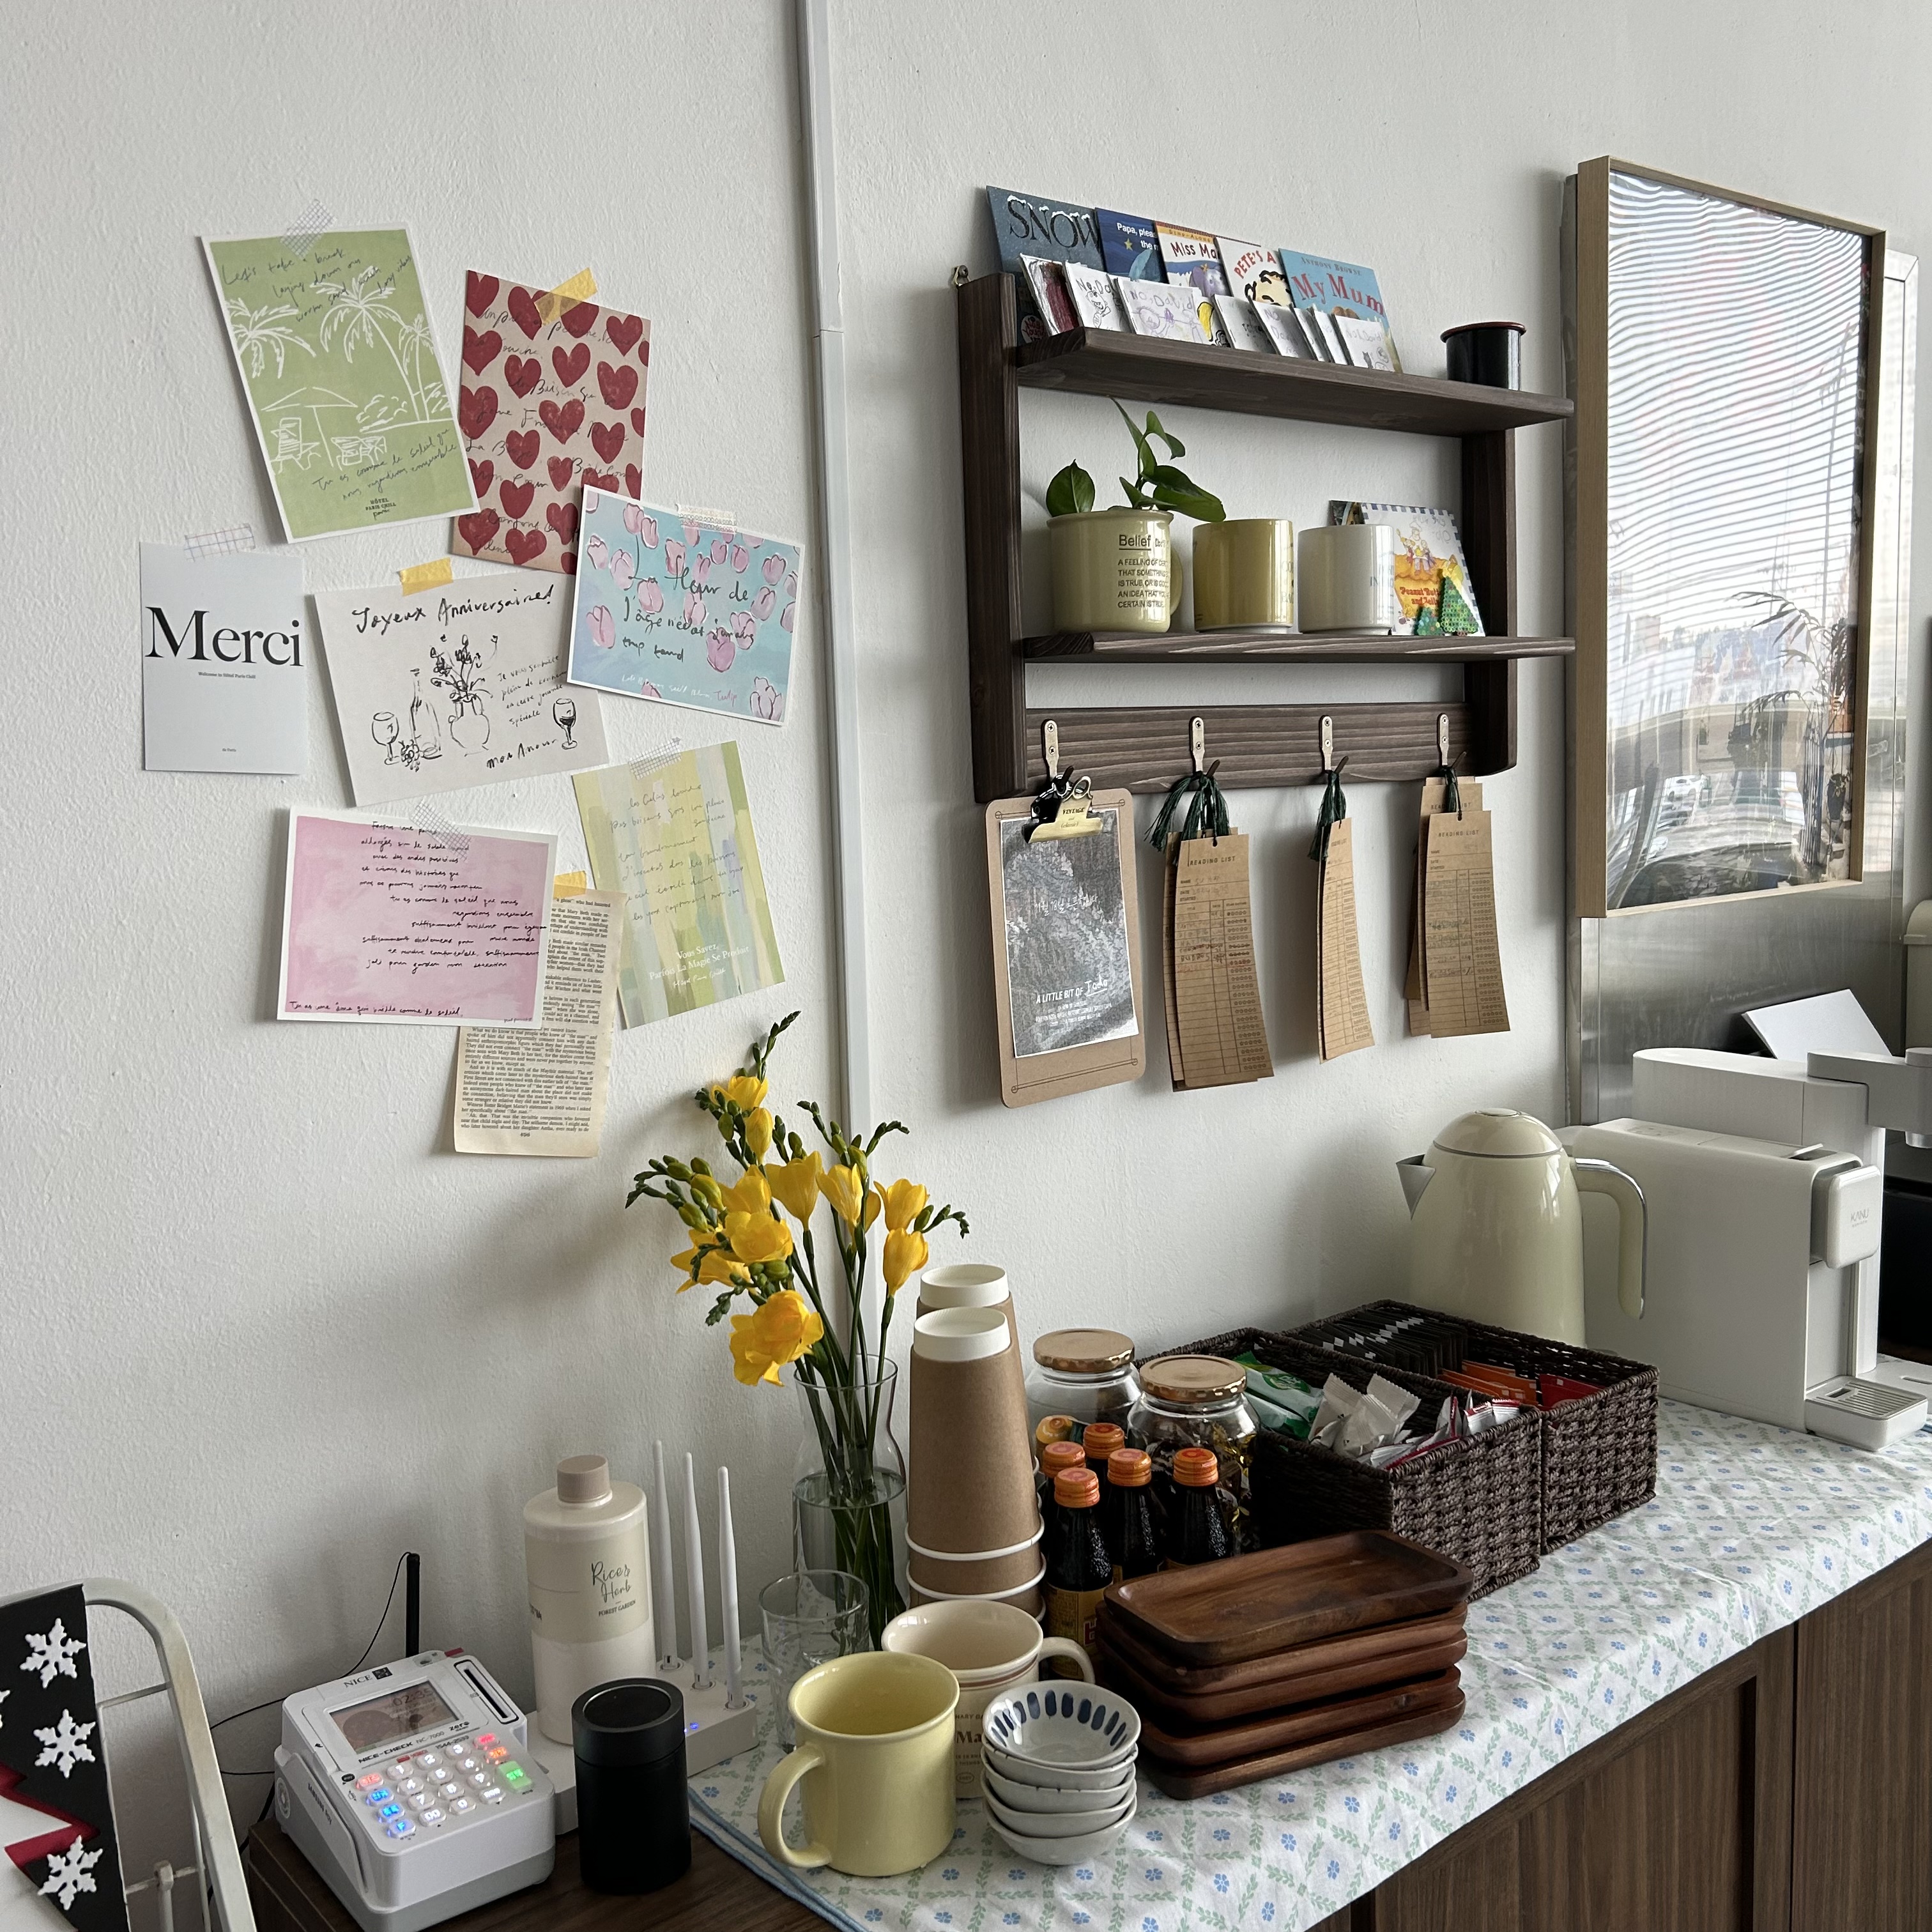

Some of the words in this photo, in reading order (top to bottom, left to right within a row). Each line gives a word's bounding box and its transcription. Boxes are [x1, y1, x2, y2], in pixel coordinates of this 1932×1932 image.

[1008, 195, 1101, 248] SNOW
[1117, 222, 1137, 234] Papa,
[1140, 240, 1153, 249] the
[1170, 241, 1196, 257] Miss
[1234, 250, 1264, 279] PETE'S
[1291, 273, 1326, 304] My
[1326, 273, 1385, 316] Mum
[1119, 534, 1151, 547] Belief
[664, 555, 722, 601] fleur
[729, 580, 749, 601] de
[1400, 586, 1423, 596] Peanut
[352, 606, 426, 634] Joyeux
[145, 606, 304, 667] Merci
[1190, 857, 1218, 866] READING
[677, 949, 695, 960] Vous
[648, 968, 675, 980] Parfois
[677, 963, 687, 973] La
[687, 958, 711, 969] Magie
[722, 945, 749, 958] Produit
[1036, 995, 1041, 1004] A
[1042, 992, 1063, 1003] LITTLE
[1064, 988, 1073, 999] BIT
[1075, 987, 1084, 996] OF
[591, 1561, 623, 1586] Rice
[601, 1579, 632, 1603] Herb
[598, 1606, 617, 1616] FOREST
[618, 1598, 636, 1612] GARDEN
[344, 1675, 373, 1688] NICE
[358, 1741, 413, 1764] NICE-CHECK
[453, 1744, 463, 1754] 3
[424, 1754, 436, 1765] 2
[395, 1765, 404, 1775] 1
[416, 1794, 425, 1805] 7
[457, 1799, 468, 1809] 0
[424, 1809, 441, 1822] 00
